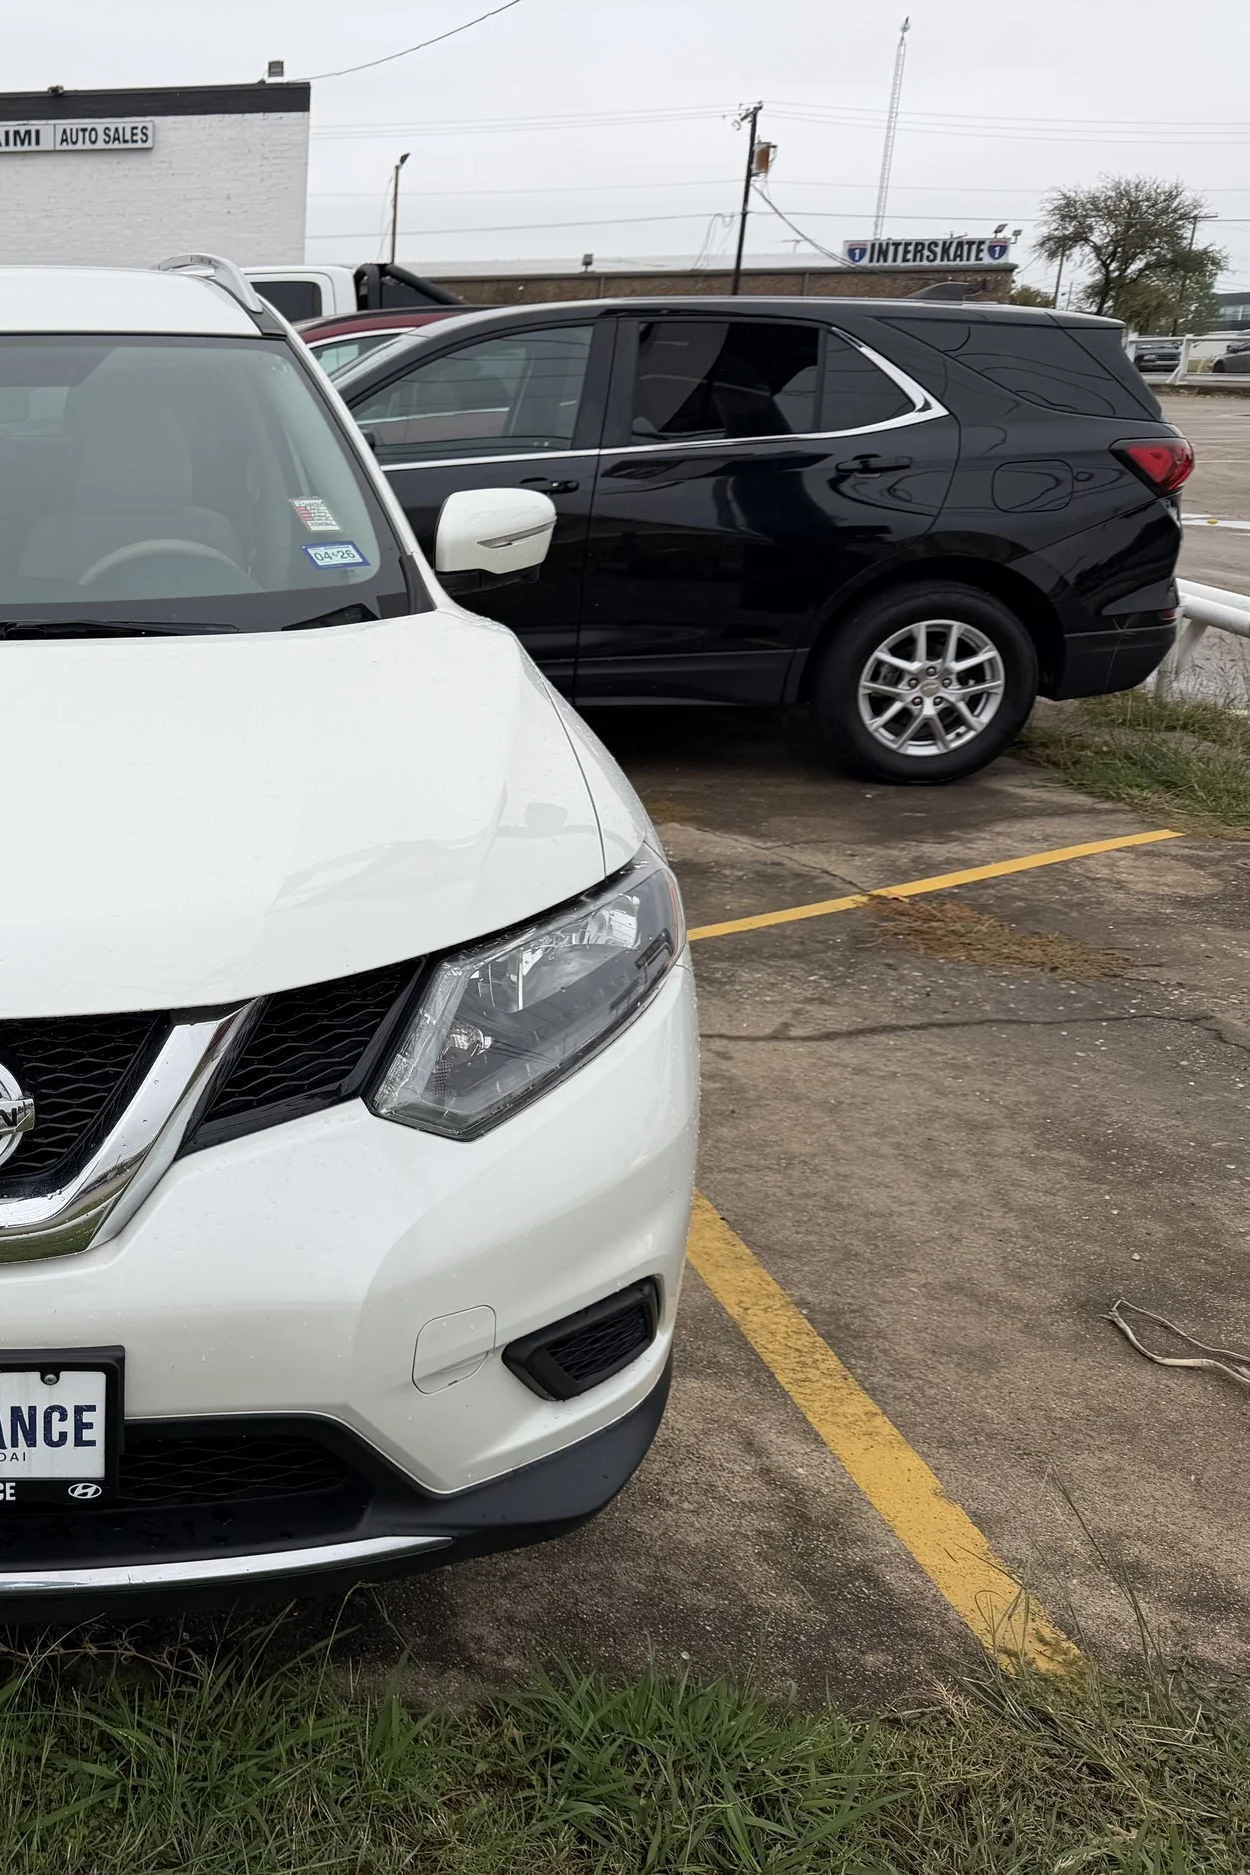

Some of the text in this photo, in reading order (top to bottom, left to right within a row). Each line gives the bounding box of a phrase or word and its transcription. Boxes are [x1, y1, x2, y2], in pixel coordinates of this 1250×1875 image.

[60, 127, 98, 146] AUTO
[103, 125, 149, 144] SALES
[869, 241, 985, 263] INTERSKATE
